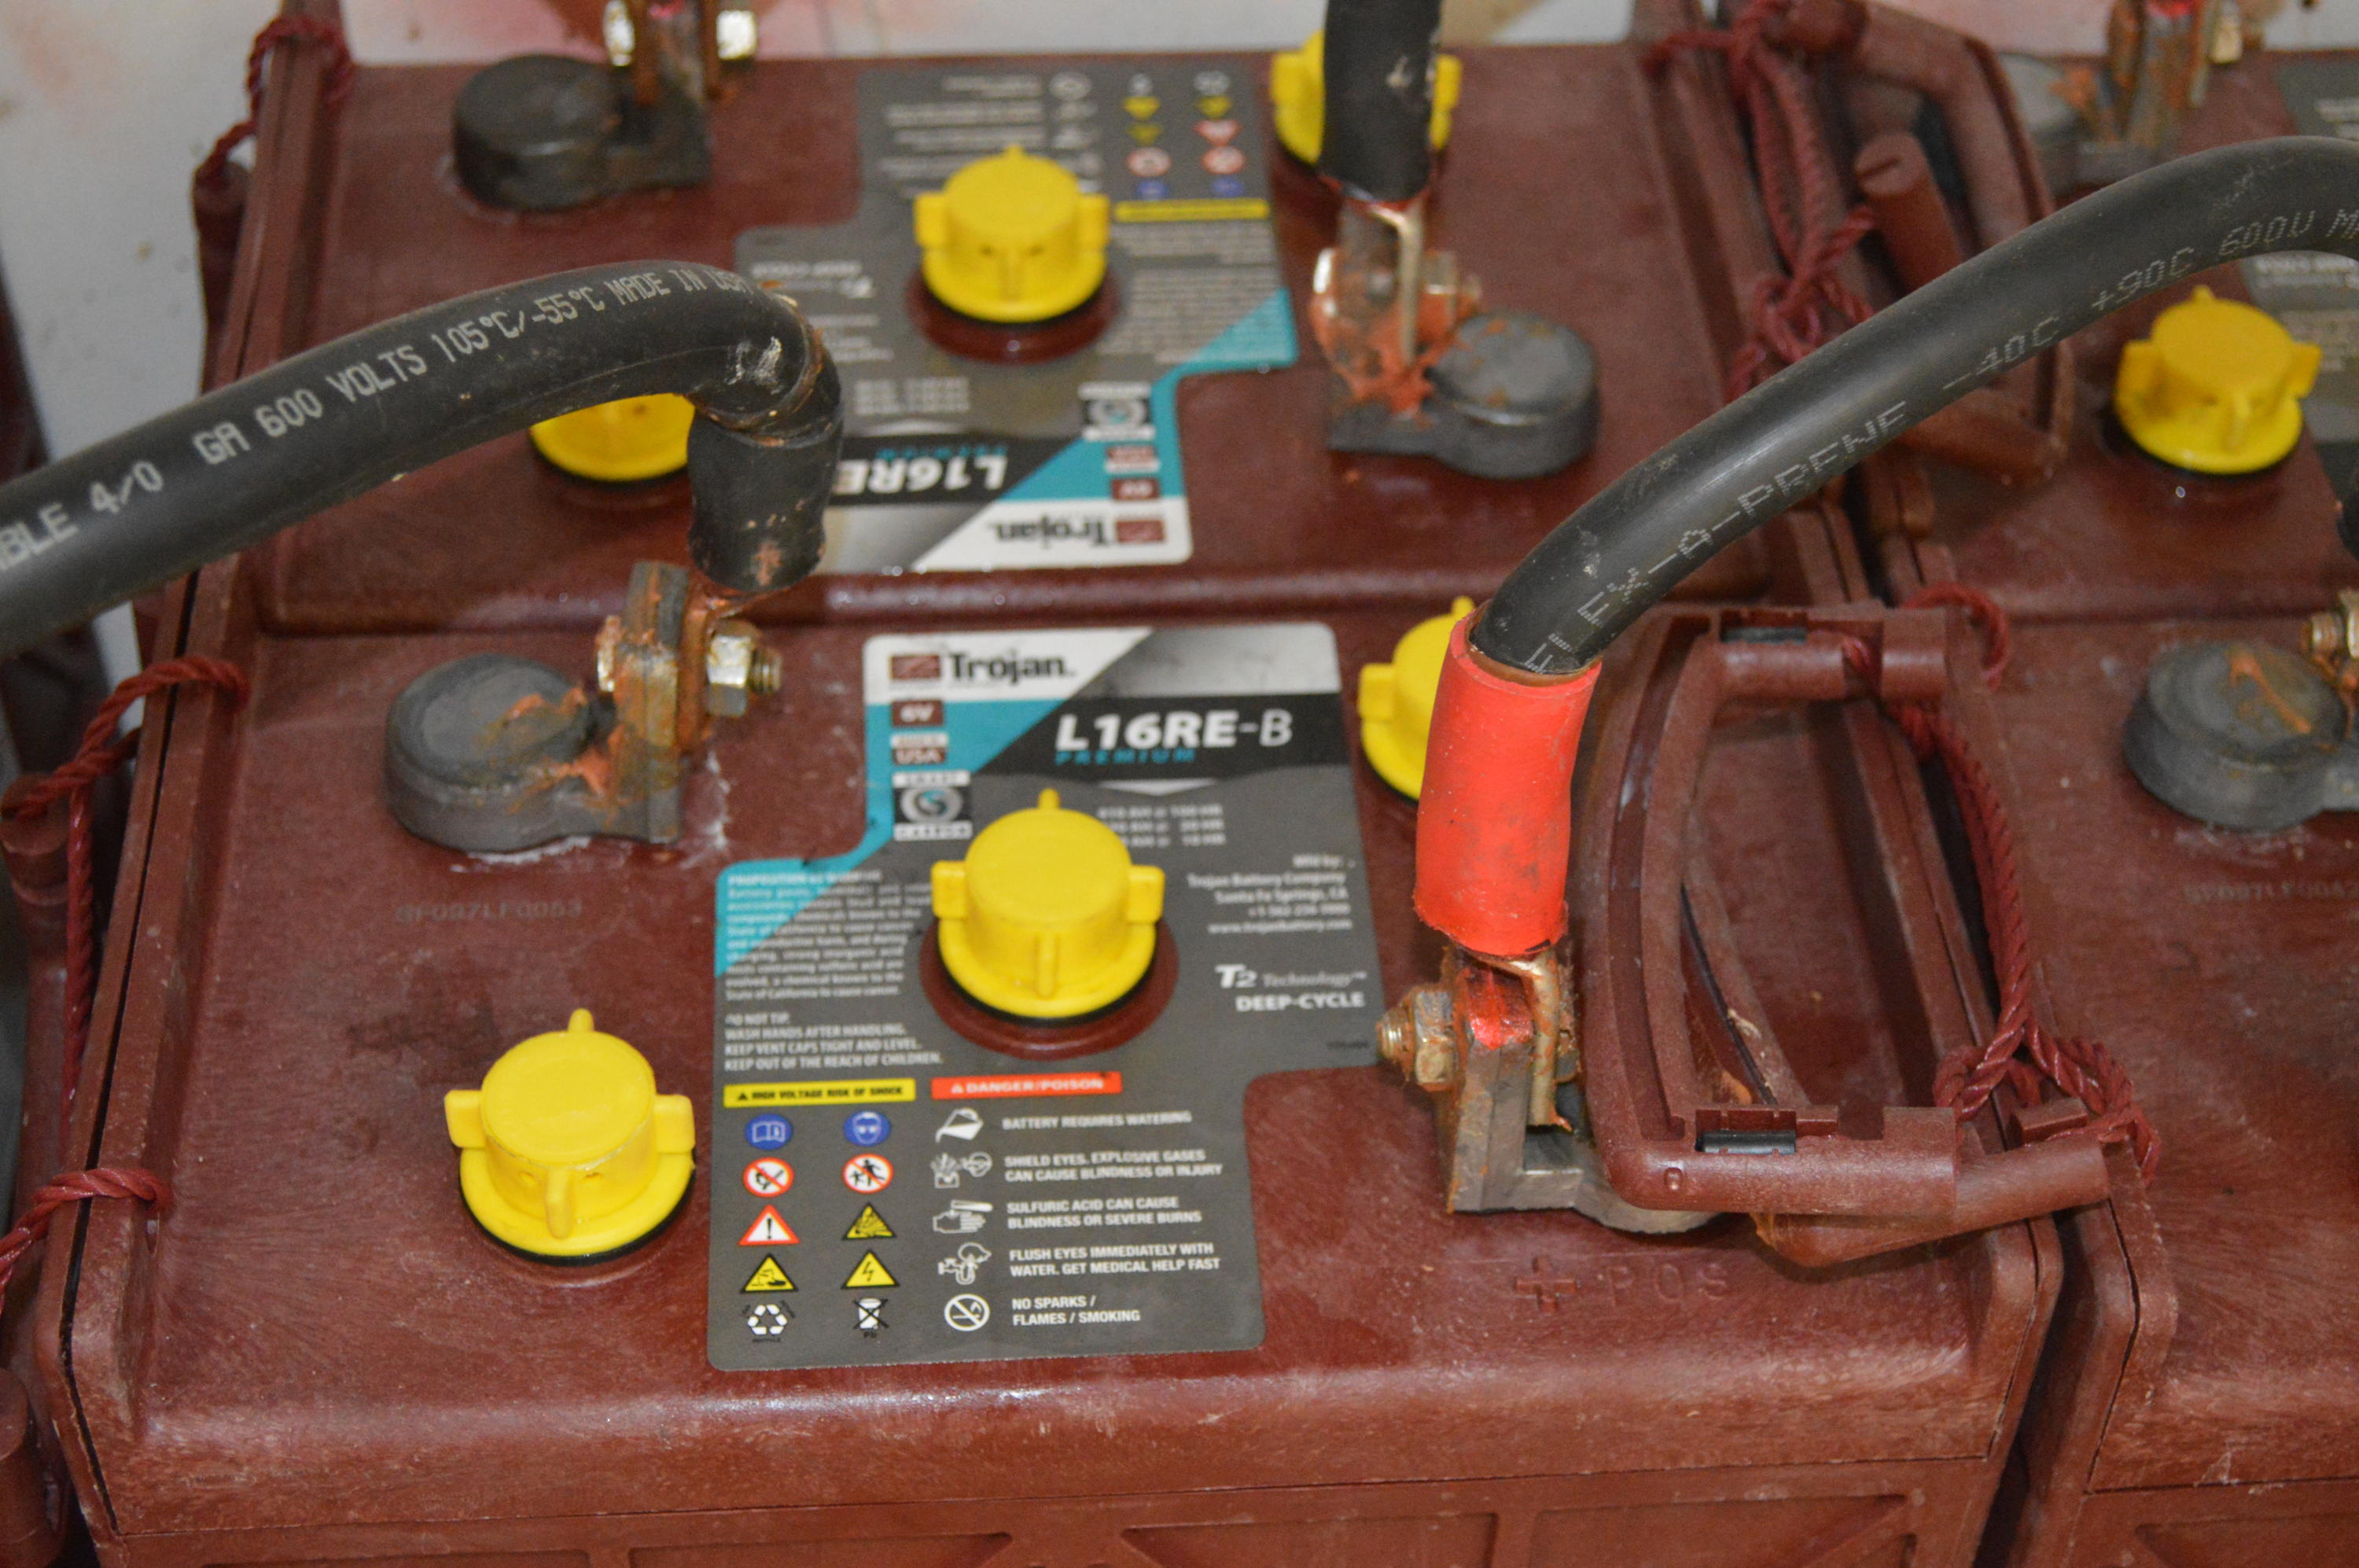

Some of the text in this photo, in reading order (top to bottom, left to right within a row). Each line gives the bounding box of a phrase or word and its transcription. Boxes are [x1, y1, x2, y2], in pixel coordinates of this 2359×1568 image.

[90, 461, 164, 515] 4/0
[255, 389, 324, 438] 600
[325, 344, 429, 403] VOLTS
[604, 272, 671, 306] MADE
[668, 269, 708, 293] IN
[948, 650, 1067, 685] Trojan
[1054, 708, 1294, 751] L16RE-B
[1235, 991, 1366, 1012] DEEP-CYCLE
[1002, 1111, 1192, 1130] BATTERY REQUIRES WATERING
[1005, 1150, 1205, 1168] SHIELD EYES. EXPLOSIVE GASES
[1005, 1164, 1222, 1182] CAN CAUSE BLINDNESS OR INJURY
[1007, 1197, 1179, 1215] SULFURIC ACID CAN CAUSE
[1008, 1211, 1202, 1229] BLINDNESS OR SEVERE BURNS
[1010, 1243, 1214, 1262] FLUSH EYES IMMEDIATELY WITH
[1011, 1258, 1221, 1277] WATER. GET MEDICAL HELP FAST
[1012, 1298, 1032, 1310] NO
[1034, 1296, 1087, 1309] SPARKS
[1014, 1312, 1066, 1327] FLAMES
[1078, 1310, 1140, 1324] SMOKING
